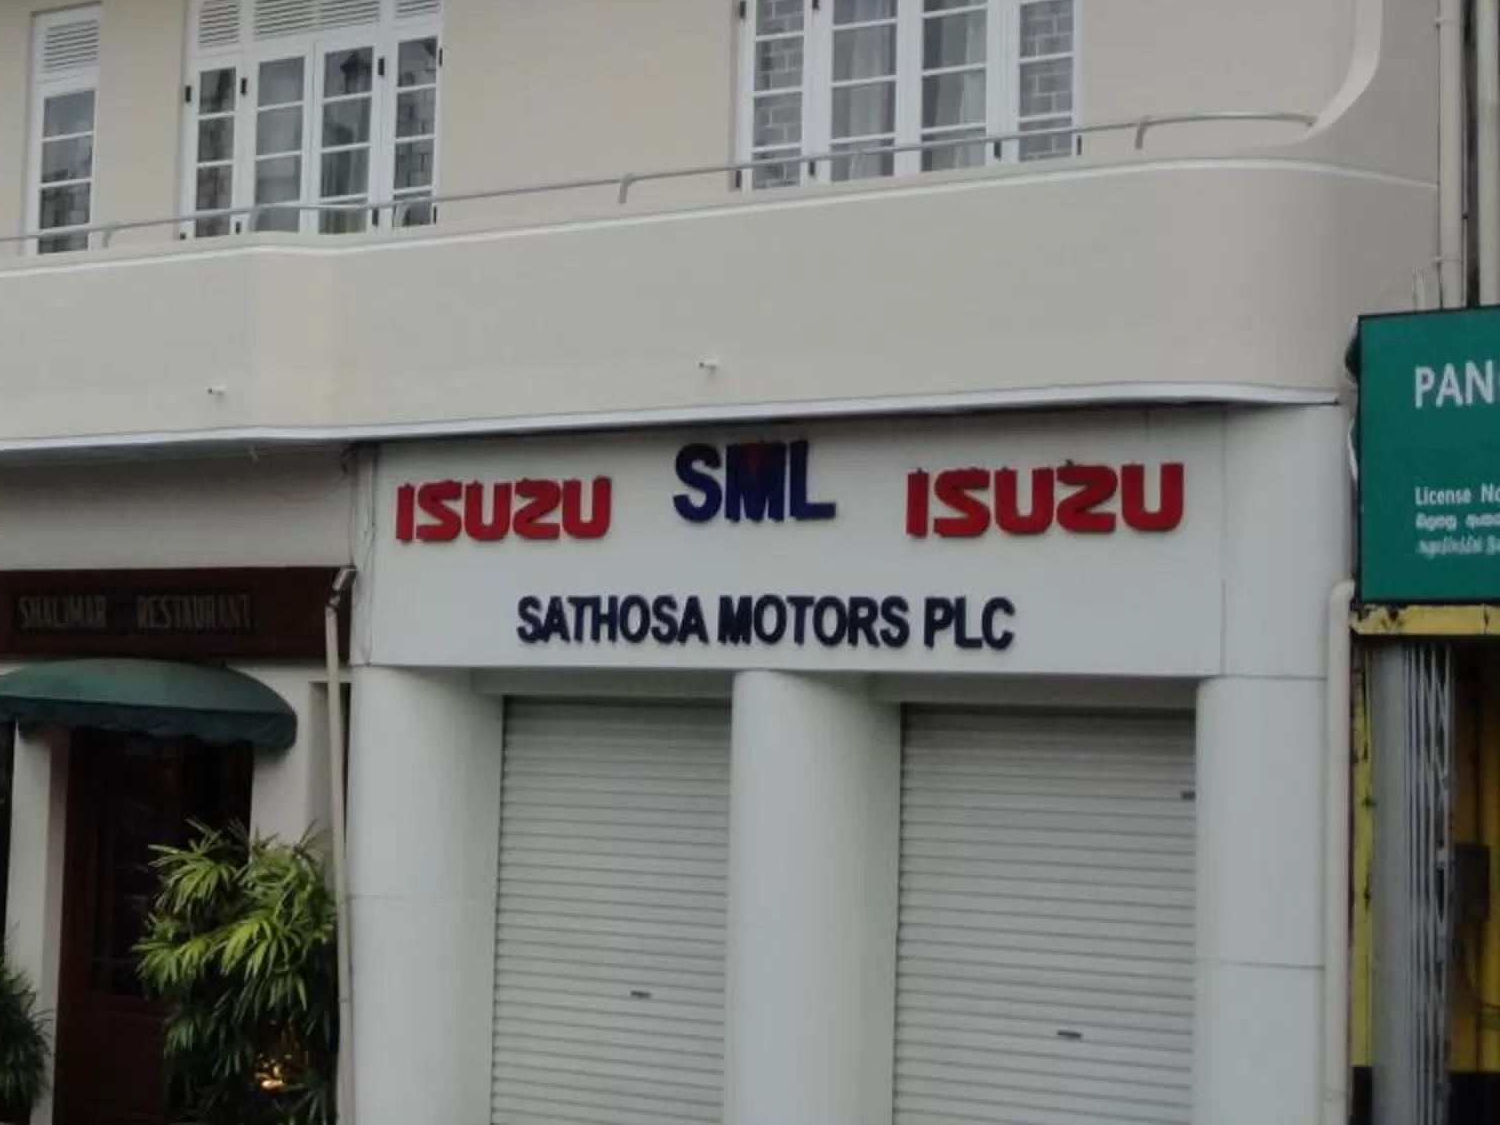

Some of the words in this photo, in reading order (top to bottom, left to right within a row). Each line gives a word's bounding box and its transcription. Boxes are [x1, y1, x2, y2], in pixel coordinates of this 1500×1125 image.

[1414, 359, 1500, 410] PAN
[395, 475, 612, 543] ISUZU
[672, 440, 836, 523] SML
[905, 462, 1184, 539] ISUZU
[1415, 486, 1472, 506] License
[18, 594, 108, 631] SHALIMAR
[136, 594, 251, 631] RESTAURANT
[517, 596, 710, 646] SATHOSA
[718, 594, 910, 649] MOTORS
[924, 596, 1016, 651] PLC
